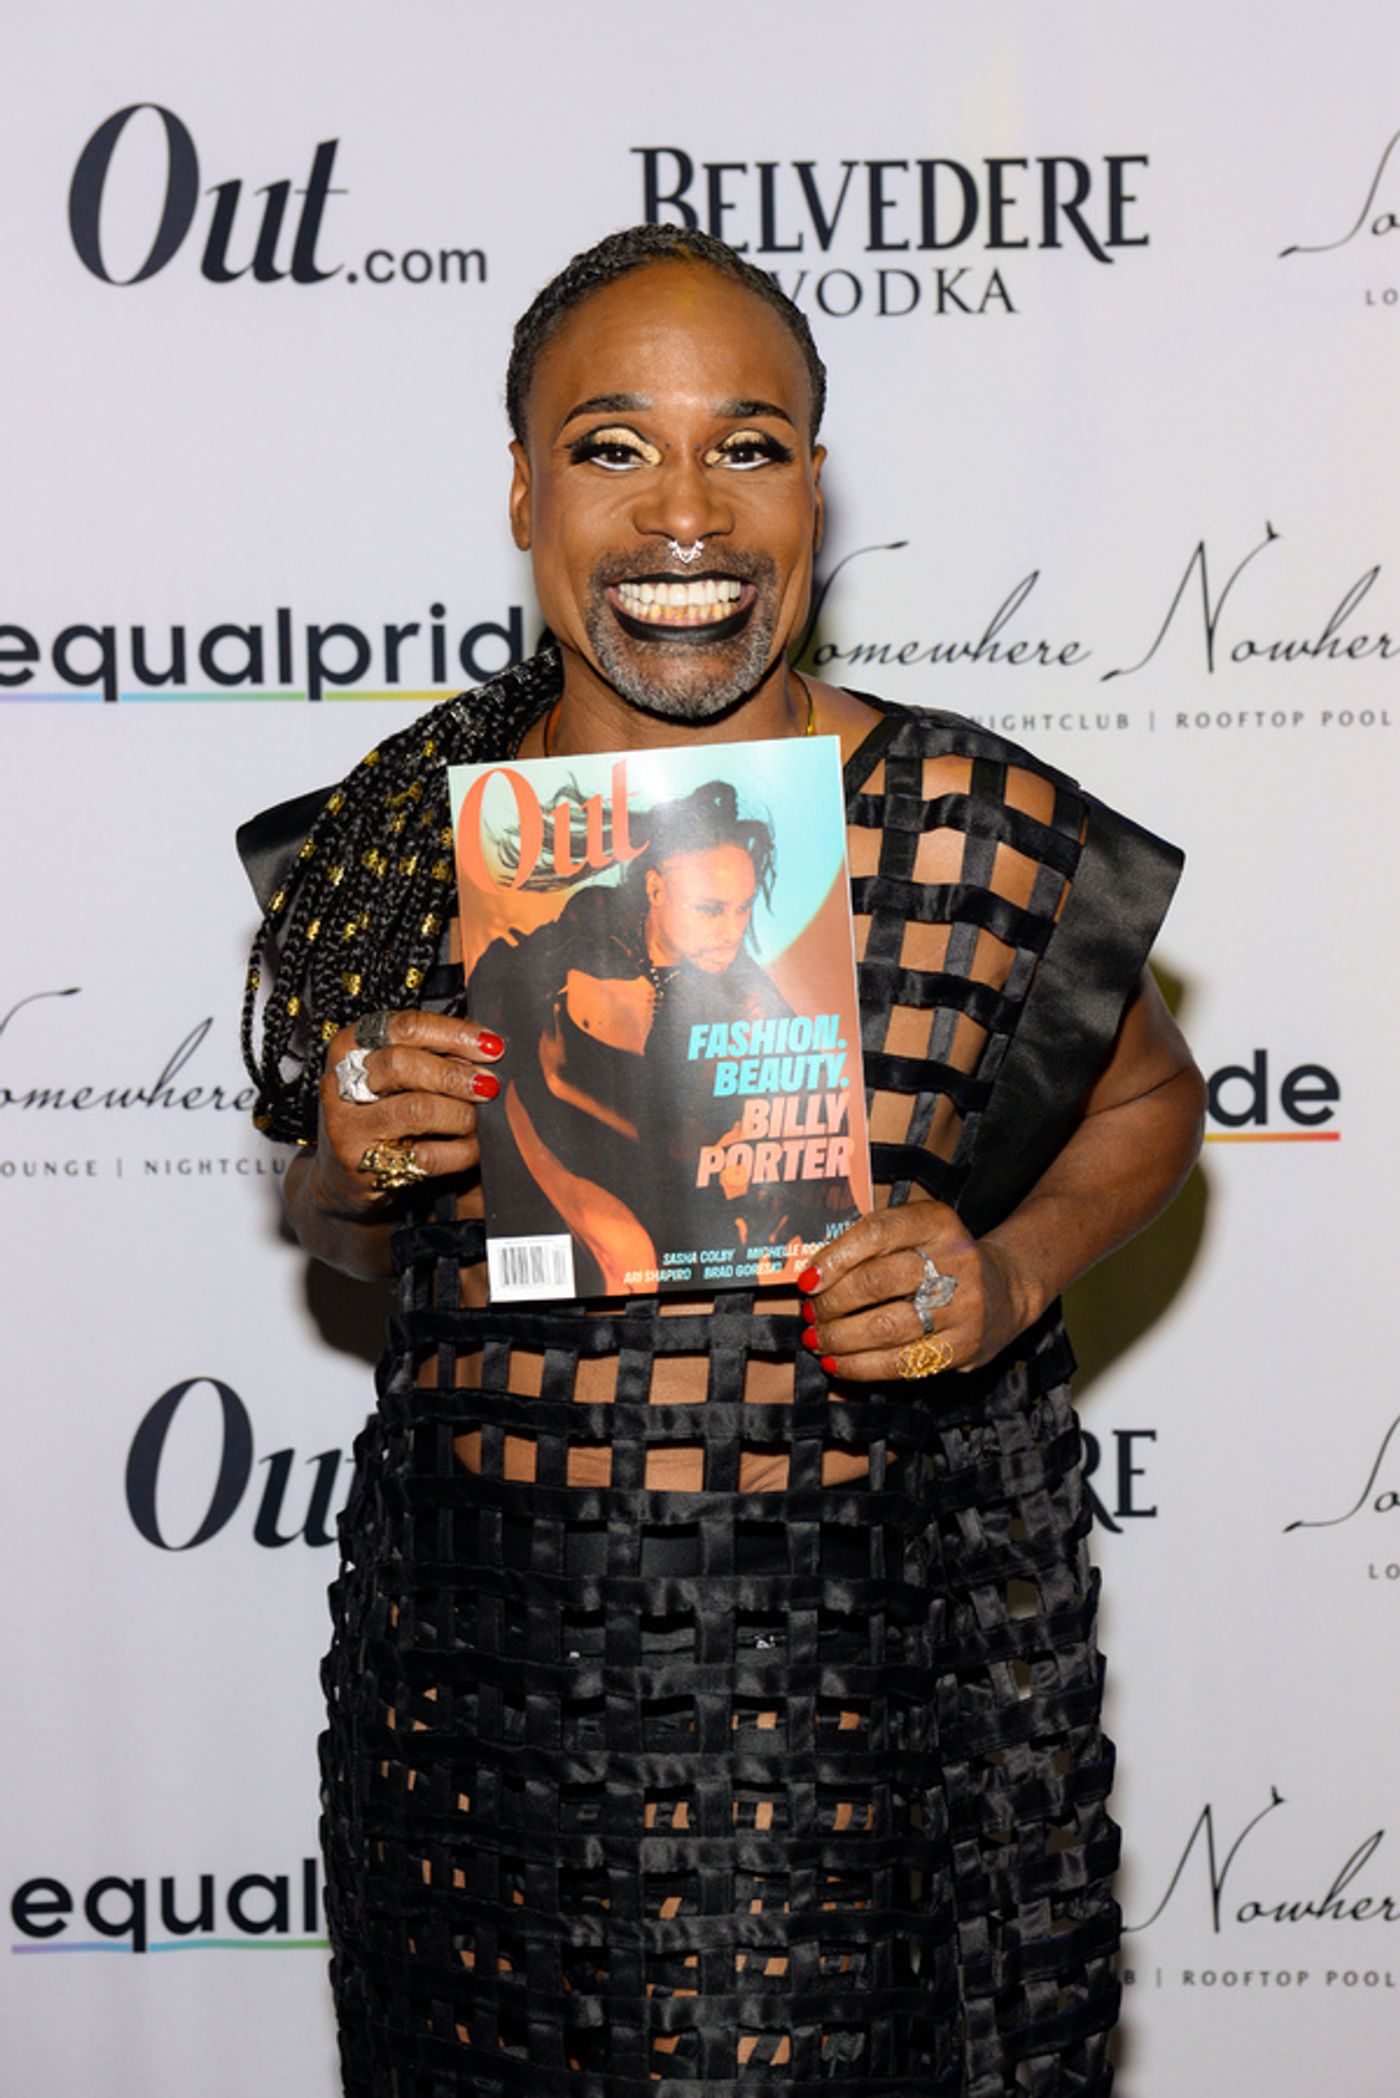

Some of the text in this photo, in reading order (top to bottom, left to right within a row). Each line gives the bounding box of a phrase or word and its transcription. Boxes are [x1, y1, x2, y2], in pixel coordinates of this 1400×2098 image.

[630, 147, 1150, 264] BELVEDERE
[1100, 520, 1400, 682] Nowher
[0, 602, 523, 702] equalprid
[1175, 710, 1306, 730] ROOFTOP
[1321, 709, 1392, 728] POOL
[457, 758, 650, 894] Out
[687, 1014, 848, 1061] FASHION.
[713, 1052, 850, 1097] BEAUTY.
[740, 1092, 850, 1143] BILLY
[0, 1157, 286, 1178] OUNGE NIGHTCLU
[696, 1136, 855, 1188] PORTER
[125, 1376, 357, 1551] Ou
[1121, 1784, 1400, 1938] Nowher
[11, 1857, 318, 1954] equal
[1182, 1969, 1395, 1988] ROOFTOP POOL
